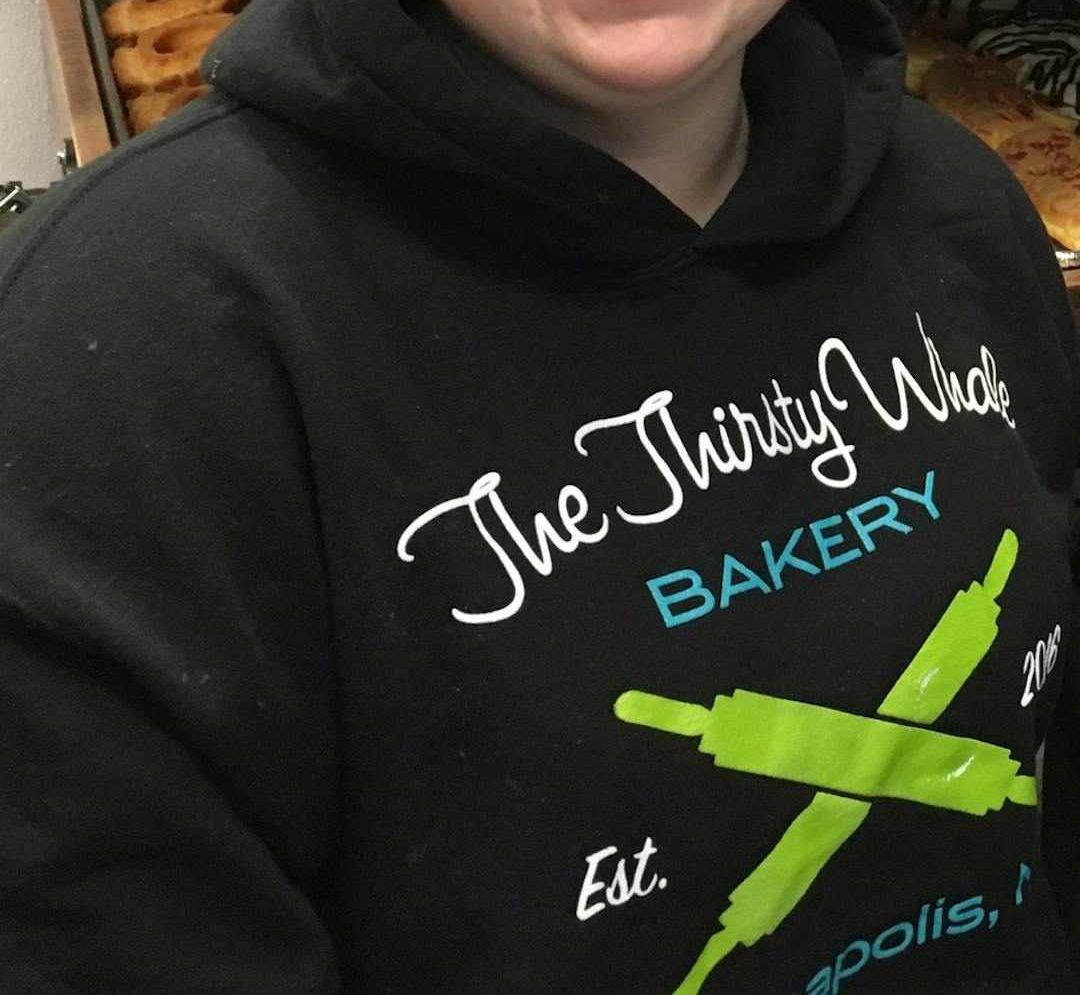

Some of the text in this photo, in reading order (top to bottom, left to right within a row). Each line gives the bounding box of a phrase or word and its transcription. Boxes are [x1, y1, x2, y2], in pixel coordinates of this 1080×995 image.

[397, 311, 1016, 625] The Thirsty Whale
[645, 469, 942, 629] BAKERY
[1020, 623, 1062, 708] 2016
[576, 836, 669, 921] Est.
